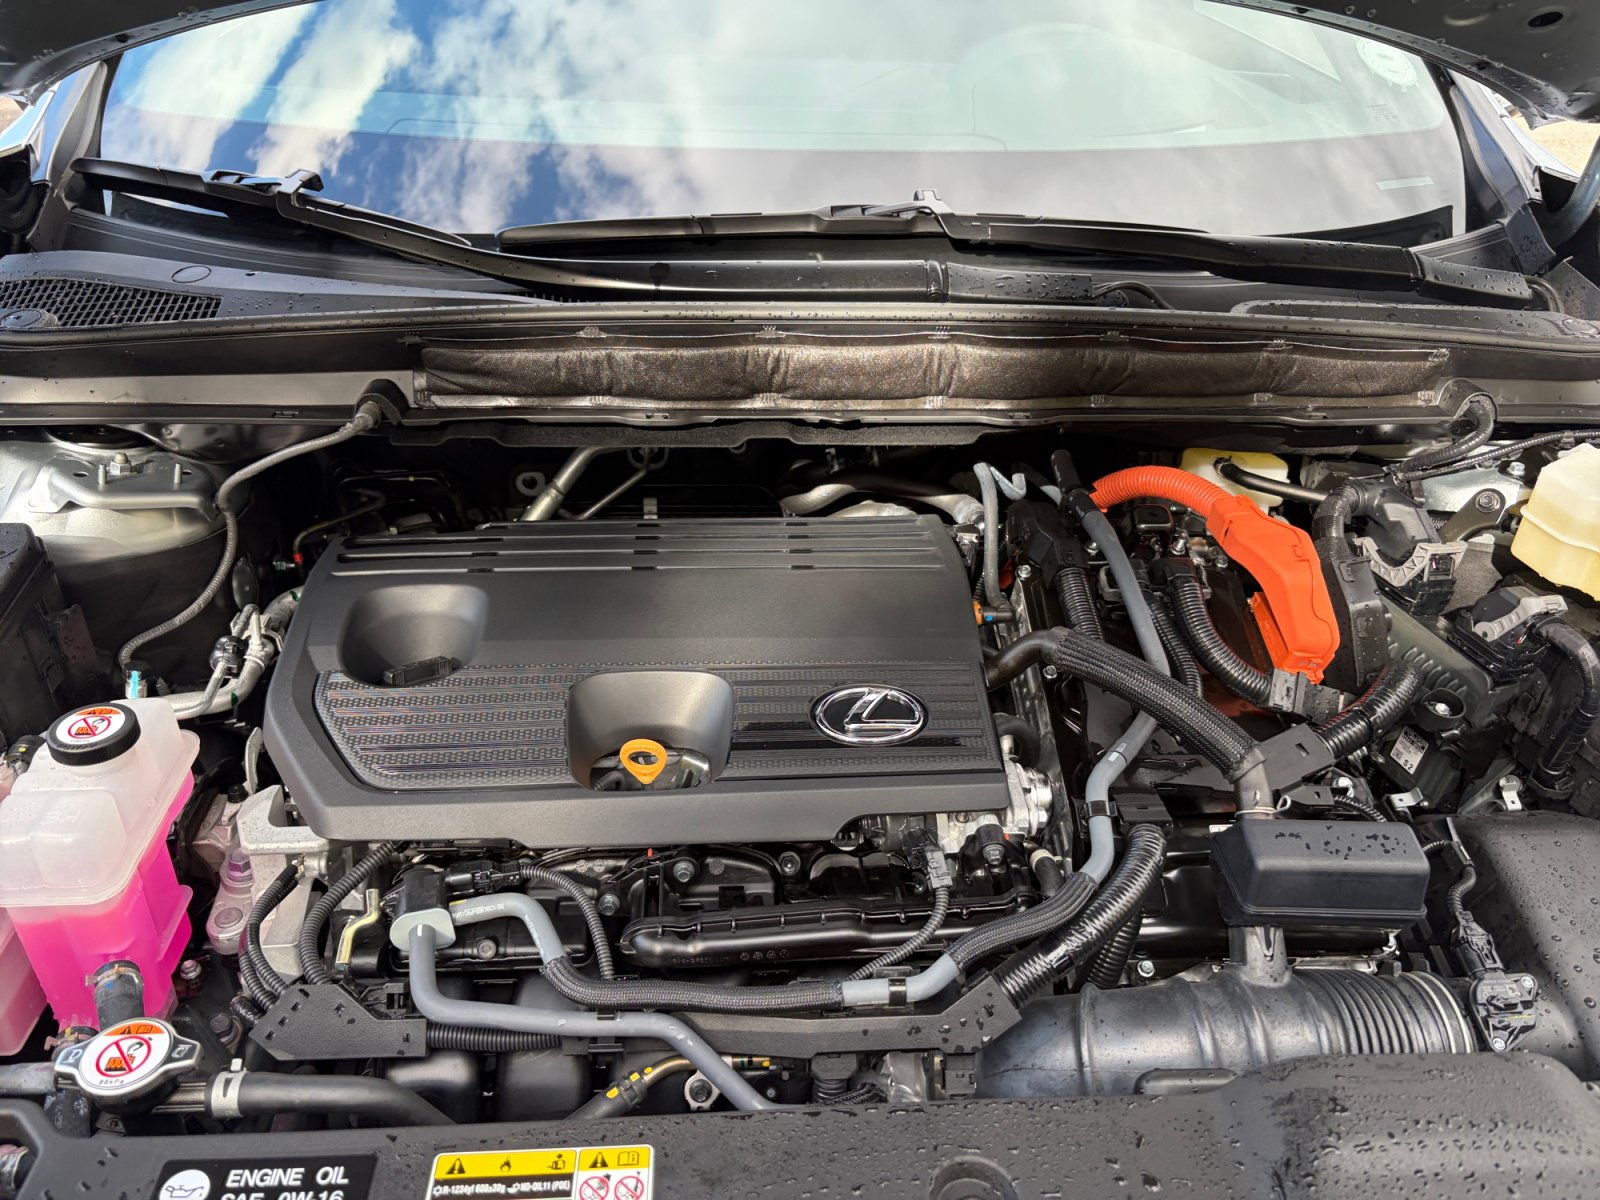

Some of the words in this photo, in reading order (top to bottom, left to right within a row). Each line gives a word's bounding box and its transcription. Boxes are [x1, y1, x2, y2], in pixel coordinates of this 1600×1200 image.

[225, 1167, 305, 1188] ENGINE
[316, 1165, 349, 1186] OIL
[551, 1179, 571, 1192] (POE)
